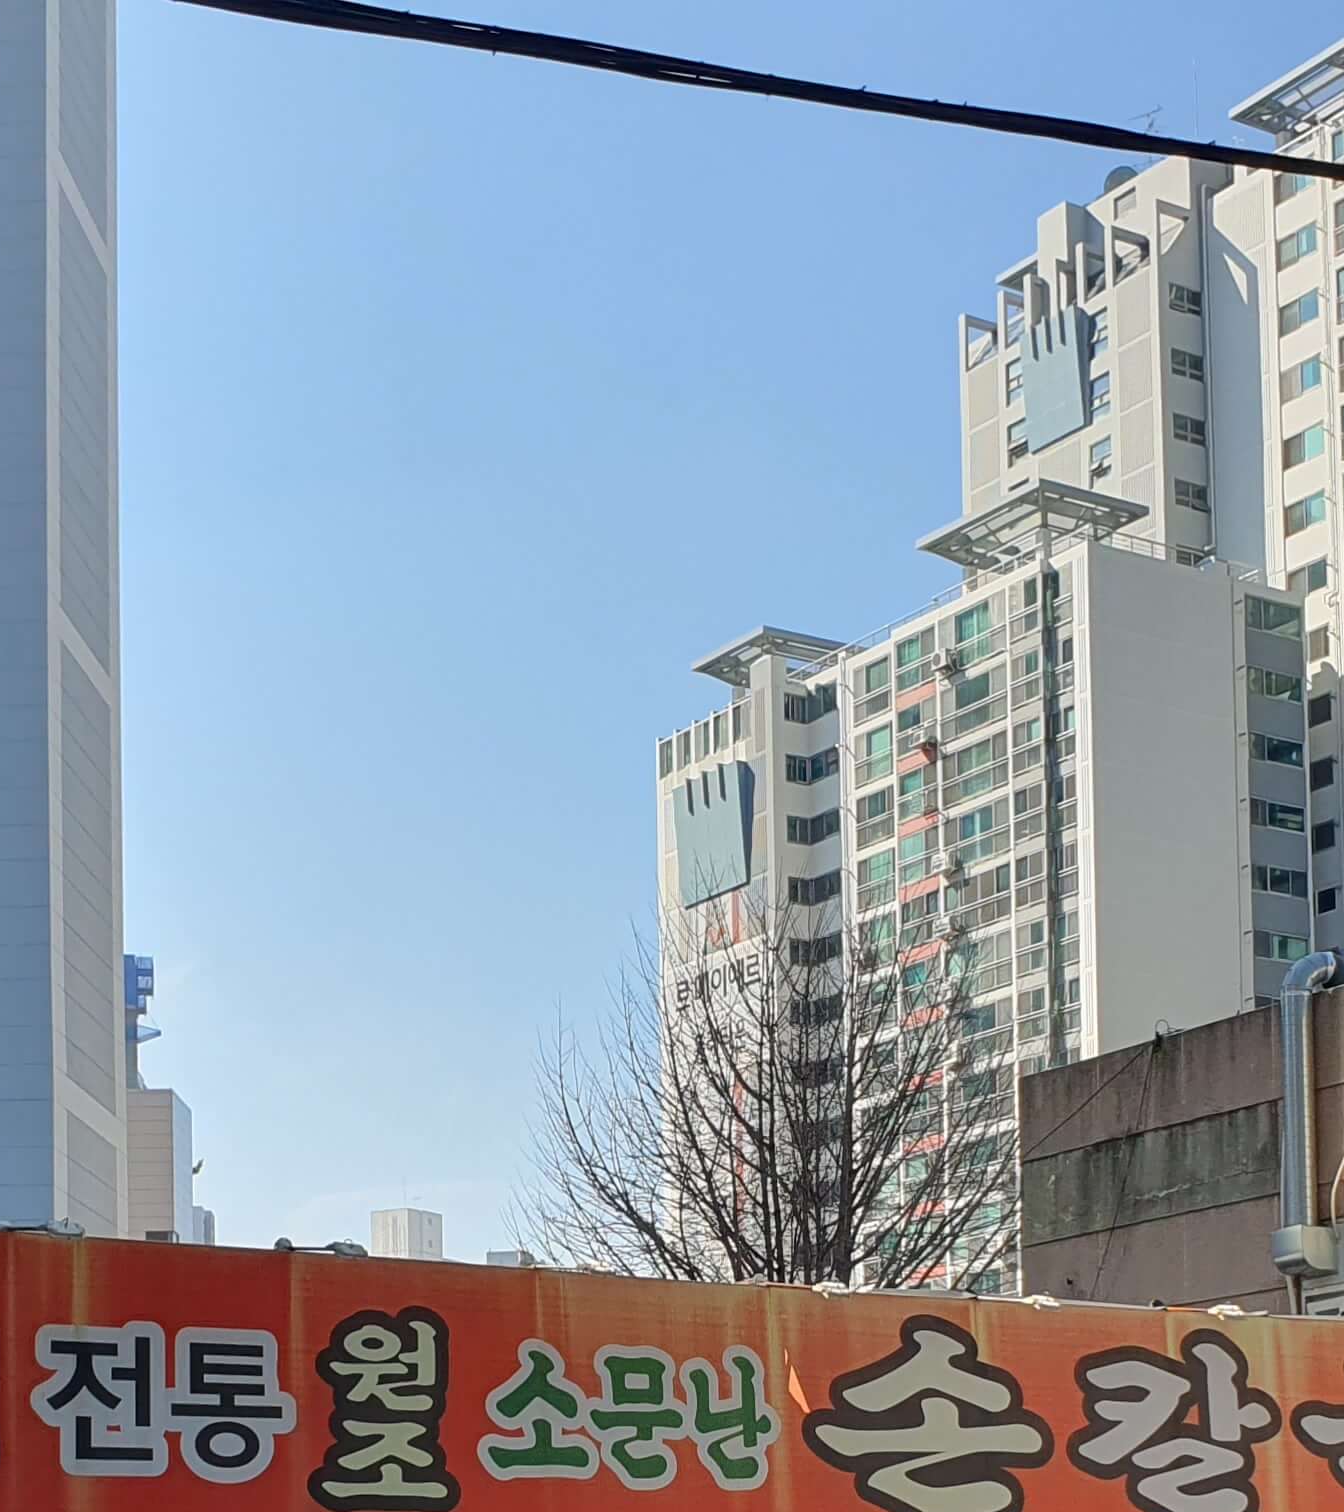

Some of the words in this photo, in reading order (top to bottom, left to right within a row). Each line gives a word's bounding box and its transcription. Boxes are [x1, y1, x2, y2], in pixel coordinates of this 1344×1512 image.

[30, 1321, 297, 1484] 전통
[307, 1306, 461, 1512] 원조
[477, 1338, 780, 1491] 소문난
